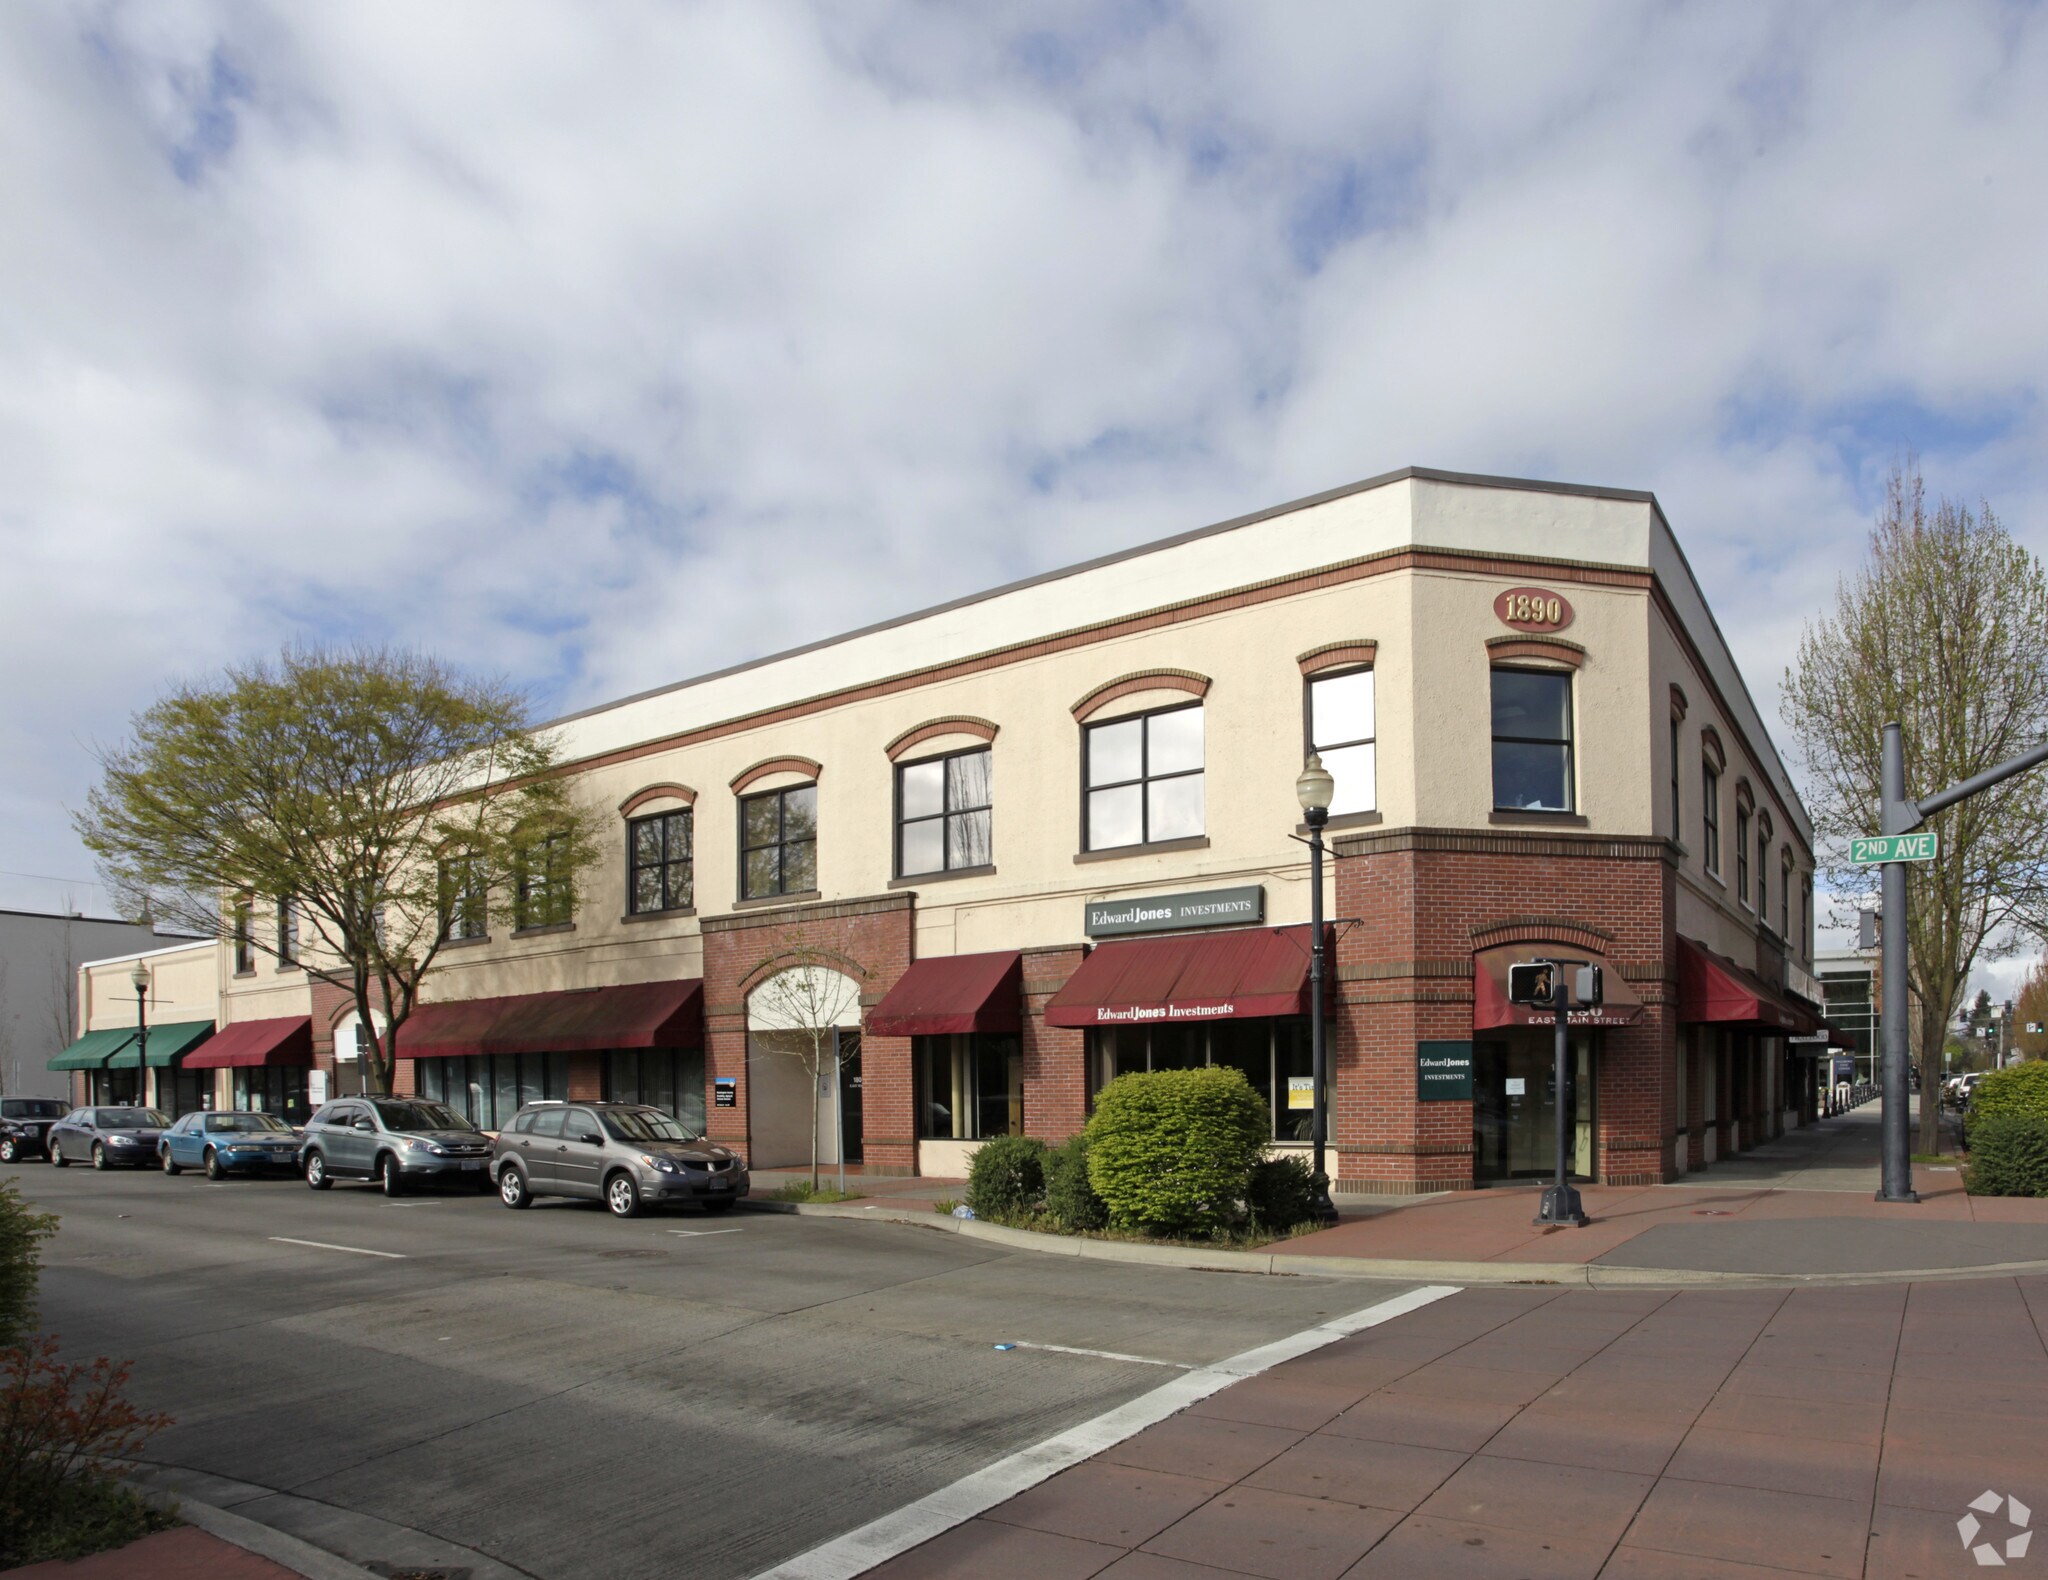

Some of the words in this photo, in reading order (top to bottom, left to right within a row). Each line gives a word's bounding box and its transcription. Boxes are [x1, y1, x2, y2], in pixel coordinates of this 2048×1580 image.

[1506, 594, 1562, 624] 1890
[1855, 840, 1888, 860] 2ND
[1894, 836, 1930, 858] AVE
[1180, 900, 1251, 917] INVESTMENTS
[1168, 1003, 1234, 1017] Investments
[1593, 1016, 1630, 1024] STREET
